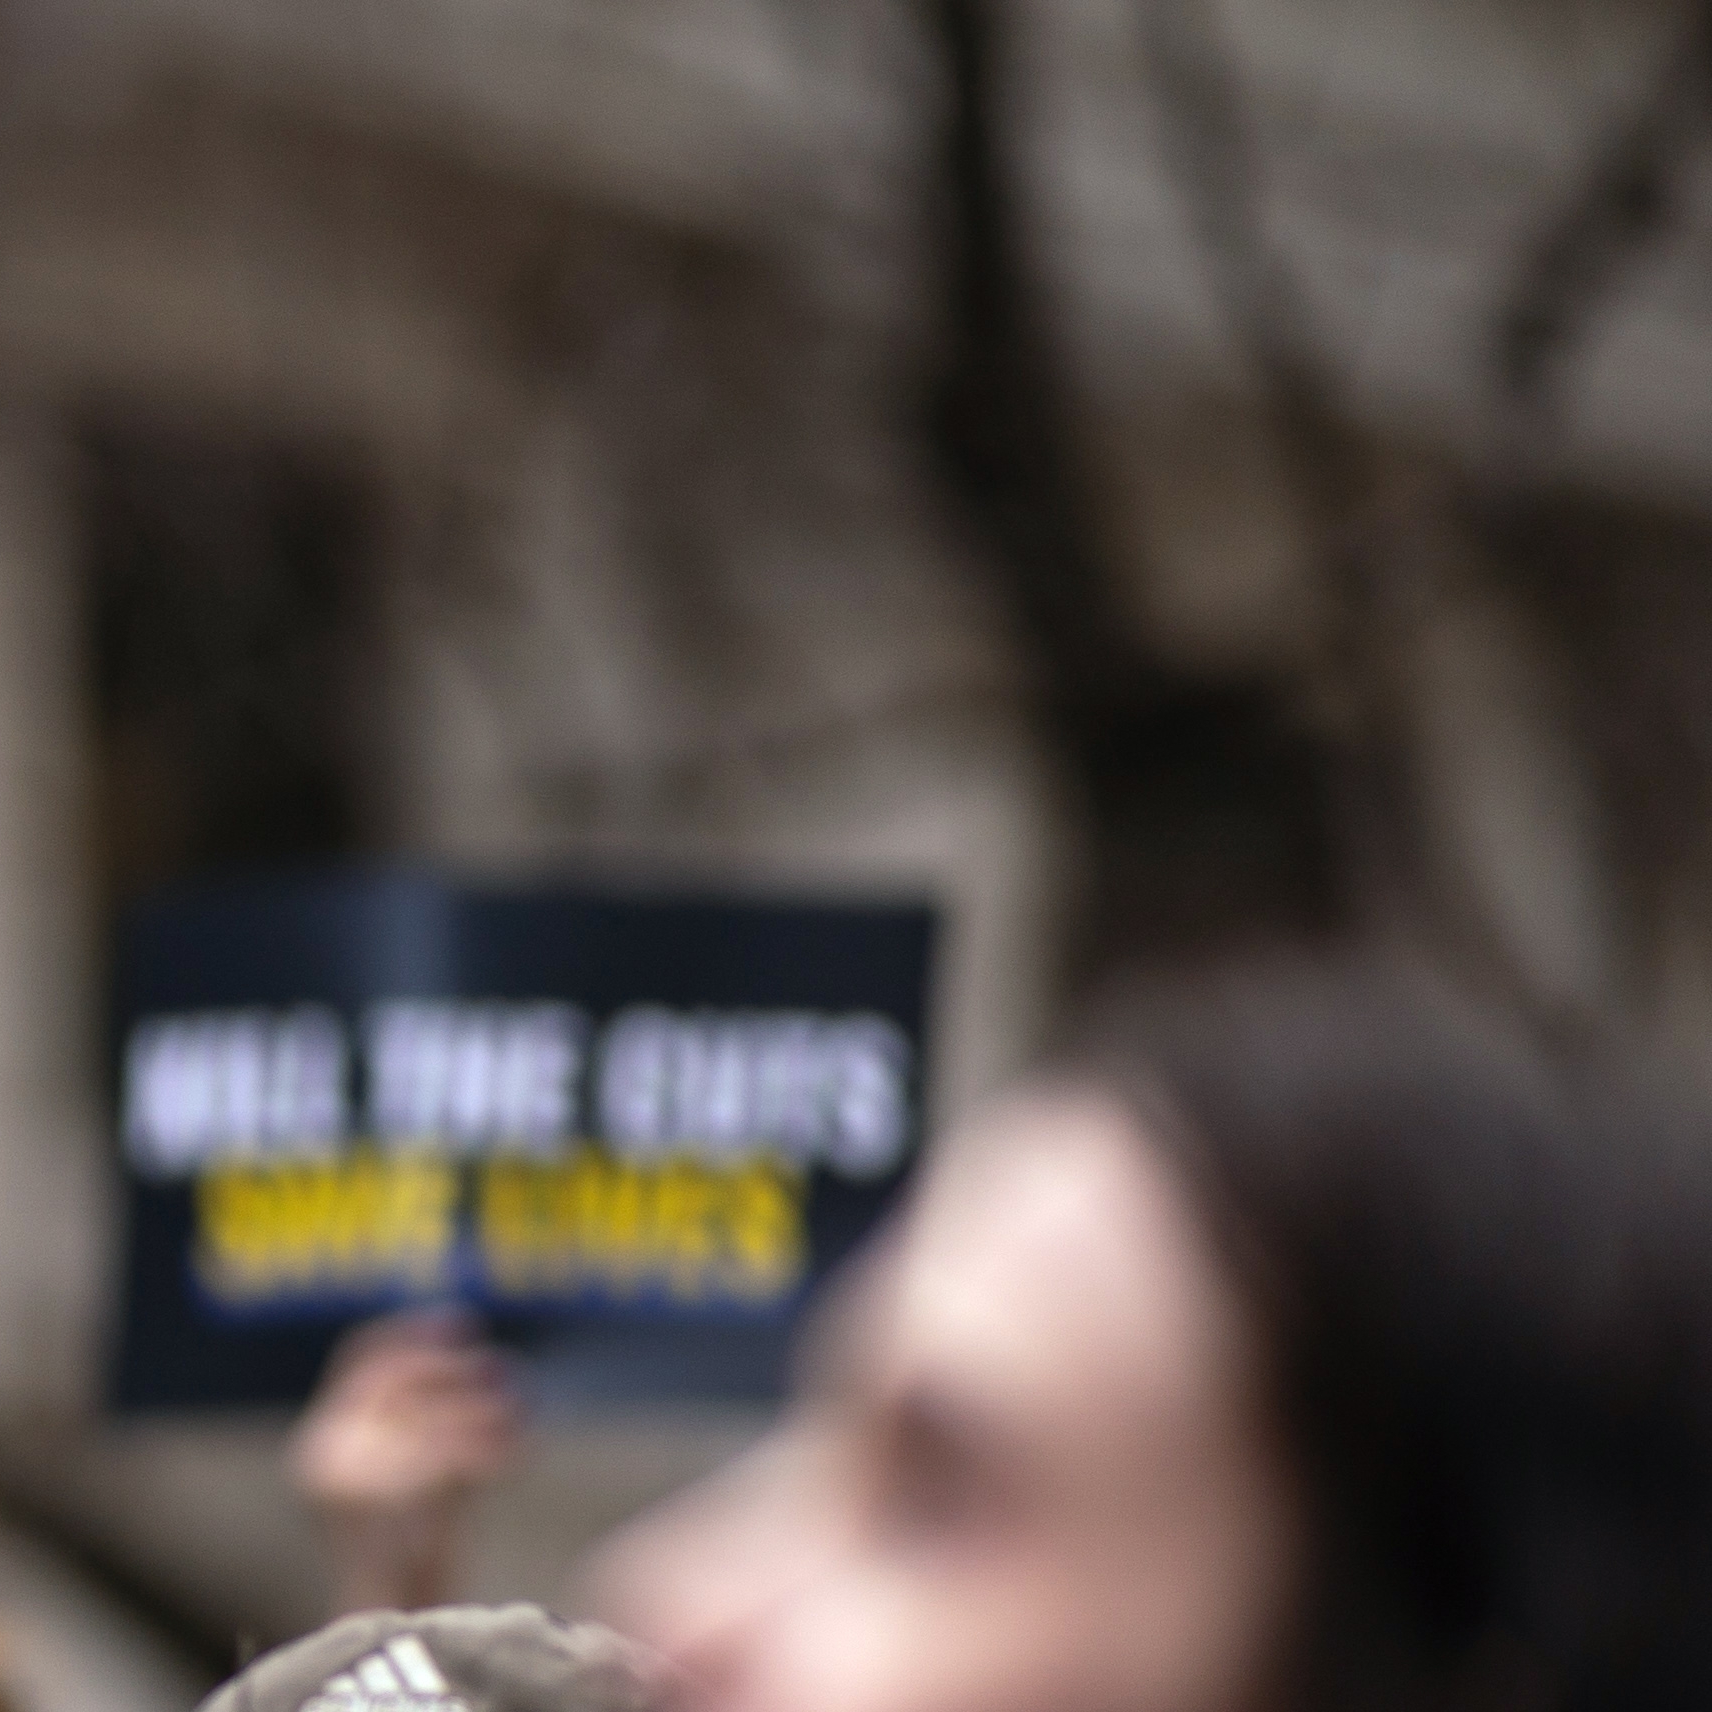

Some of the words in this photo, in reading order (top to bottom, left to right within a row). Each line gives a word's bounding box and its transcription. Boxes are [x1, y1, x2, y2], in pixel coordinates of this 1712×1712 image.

[122, 1006, 349, 1180] KILL
[367, 1000, 579, 1165] THE
[595, 1003, 914, 1185] CUTS
[197, 1142, 460, 1305] SAVE
[475, 1142, 807, 1305] LIVES
